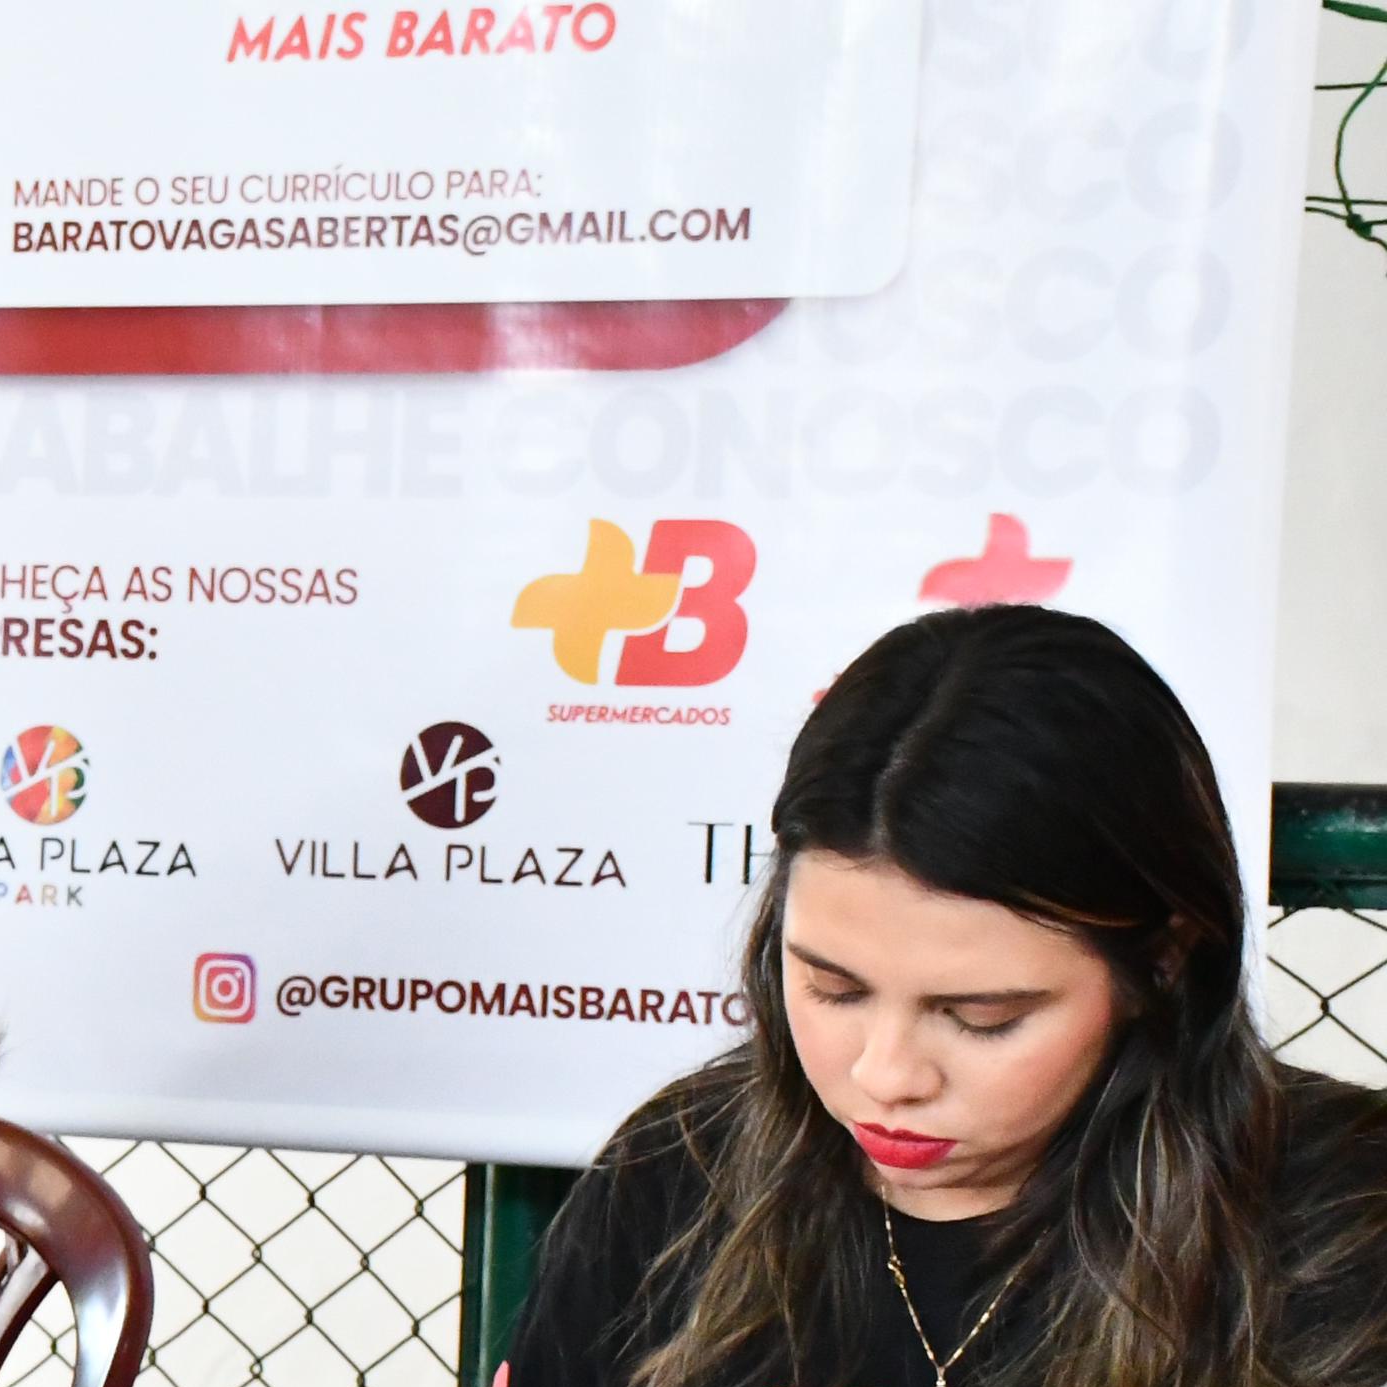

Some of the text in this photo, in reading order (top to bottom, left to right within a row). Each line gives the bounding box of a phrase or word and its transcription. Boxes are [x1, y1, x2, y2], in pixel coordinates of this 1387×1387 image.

[227, 3, 617, 62] MAIS BARATO
[13, 164, 542, 207] MANDE O SEU CURRÍCULO PARA:
[12, 207, 752, 256] BARATOVAGASABERTAS@GMAIL.COM
[123, 566, 173, 603] AS
[187, 567, 359, 605] NOSSAS
[547, 703, 733, 726] SUPERMERCADOS
[40, 837, 197, 878] PLAZA
[275, 839, 627, 888] VILLA PLAZA
